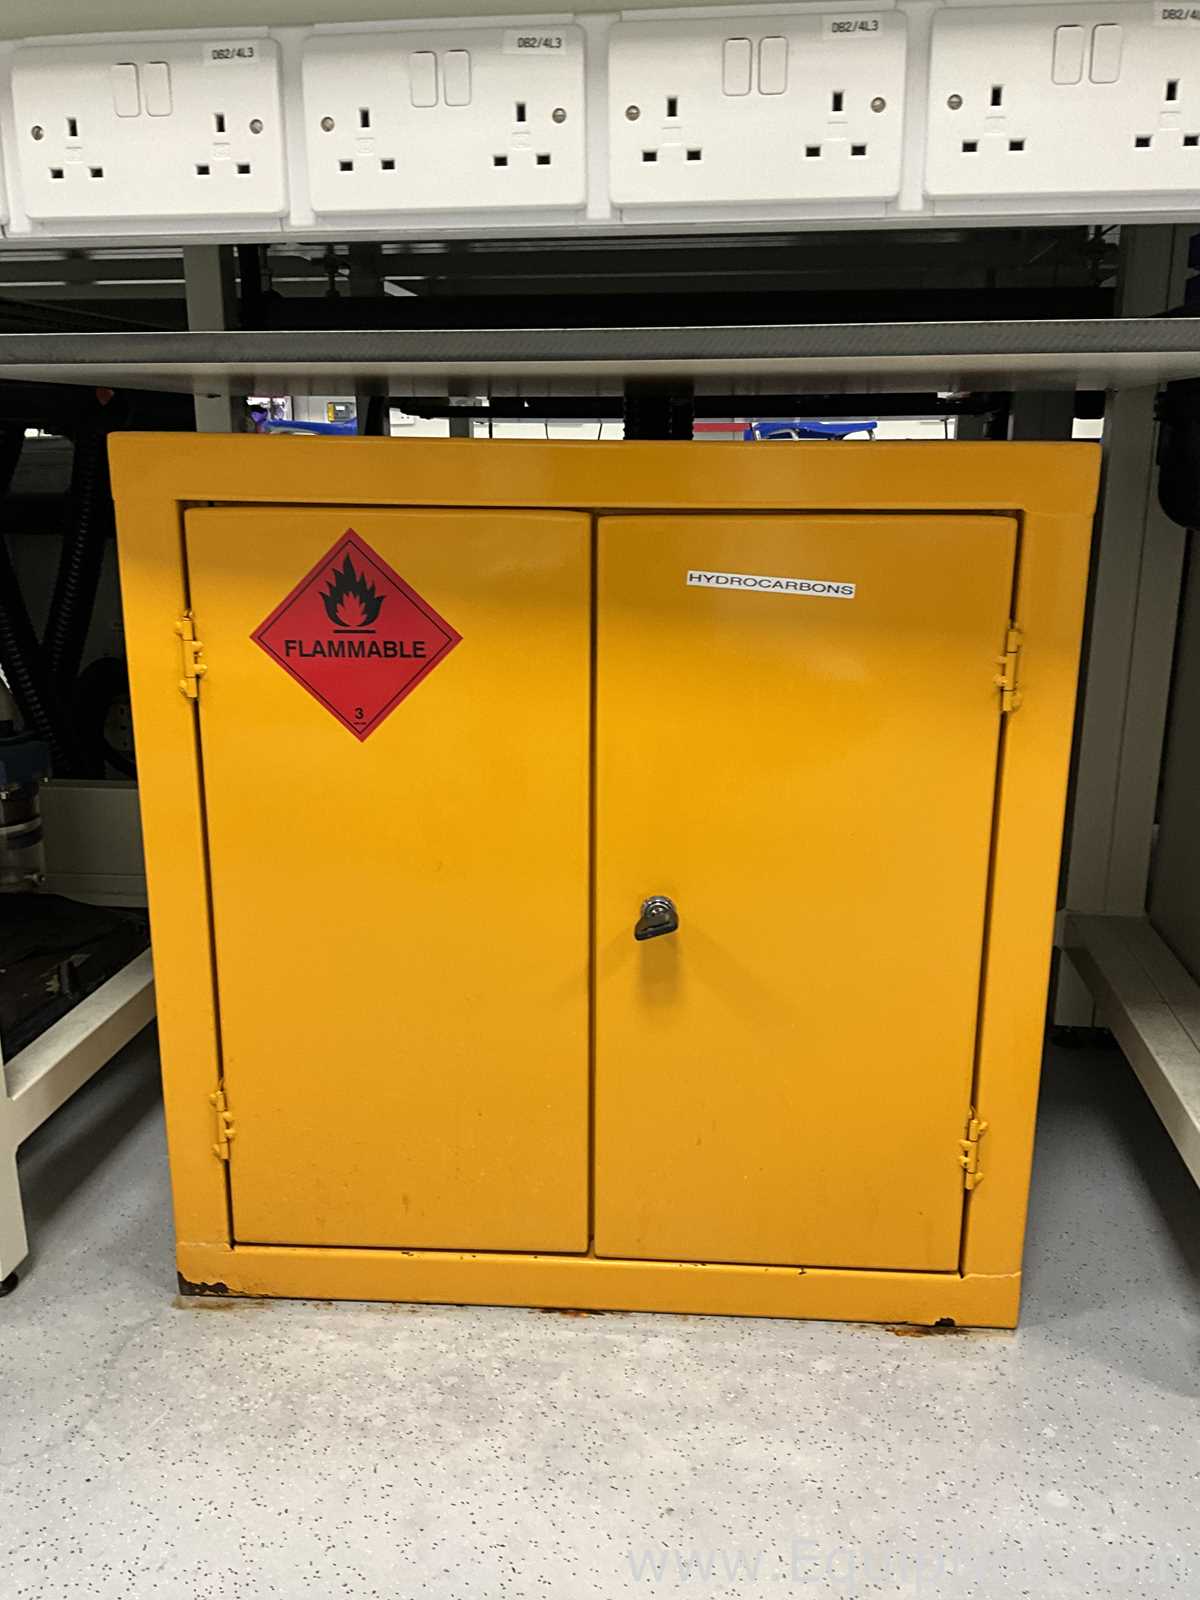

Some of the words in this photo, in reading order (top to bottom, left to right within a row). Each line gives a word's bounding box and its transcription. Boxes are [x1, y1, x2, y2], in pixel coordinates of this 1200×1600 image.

[831, 19, 879, 33] DB2/4L3
[517, 36, 562, 49] DB2/4L3
[211, 47, 254, 60] DB2/4L3
[688, 573, 854, 595] HYDROCARBONS
[284, 639, 426, 659] FLAMMABLE
[354, 707, 364, 720] 3
